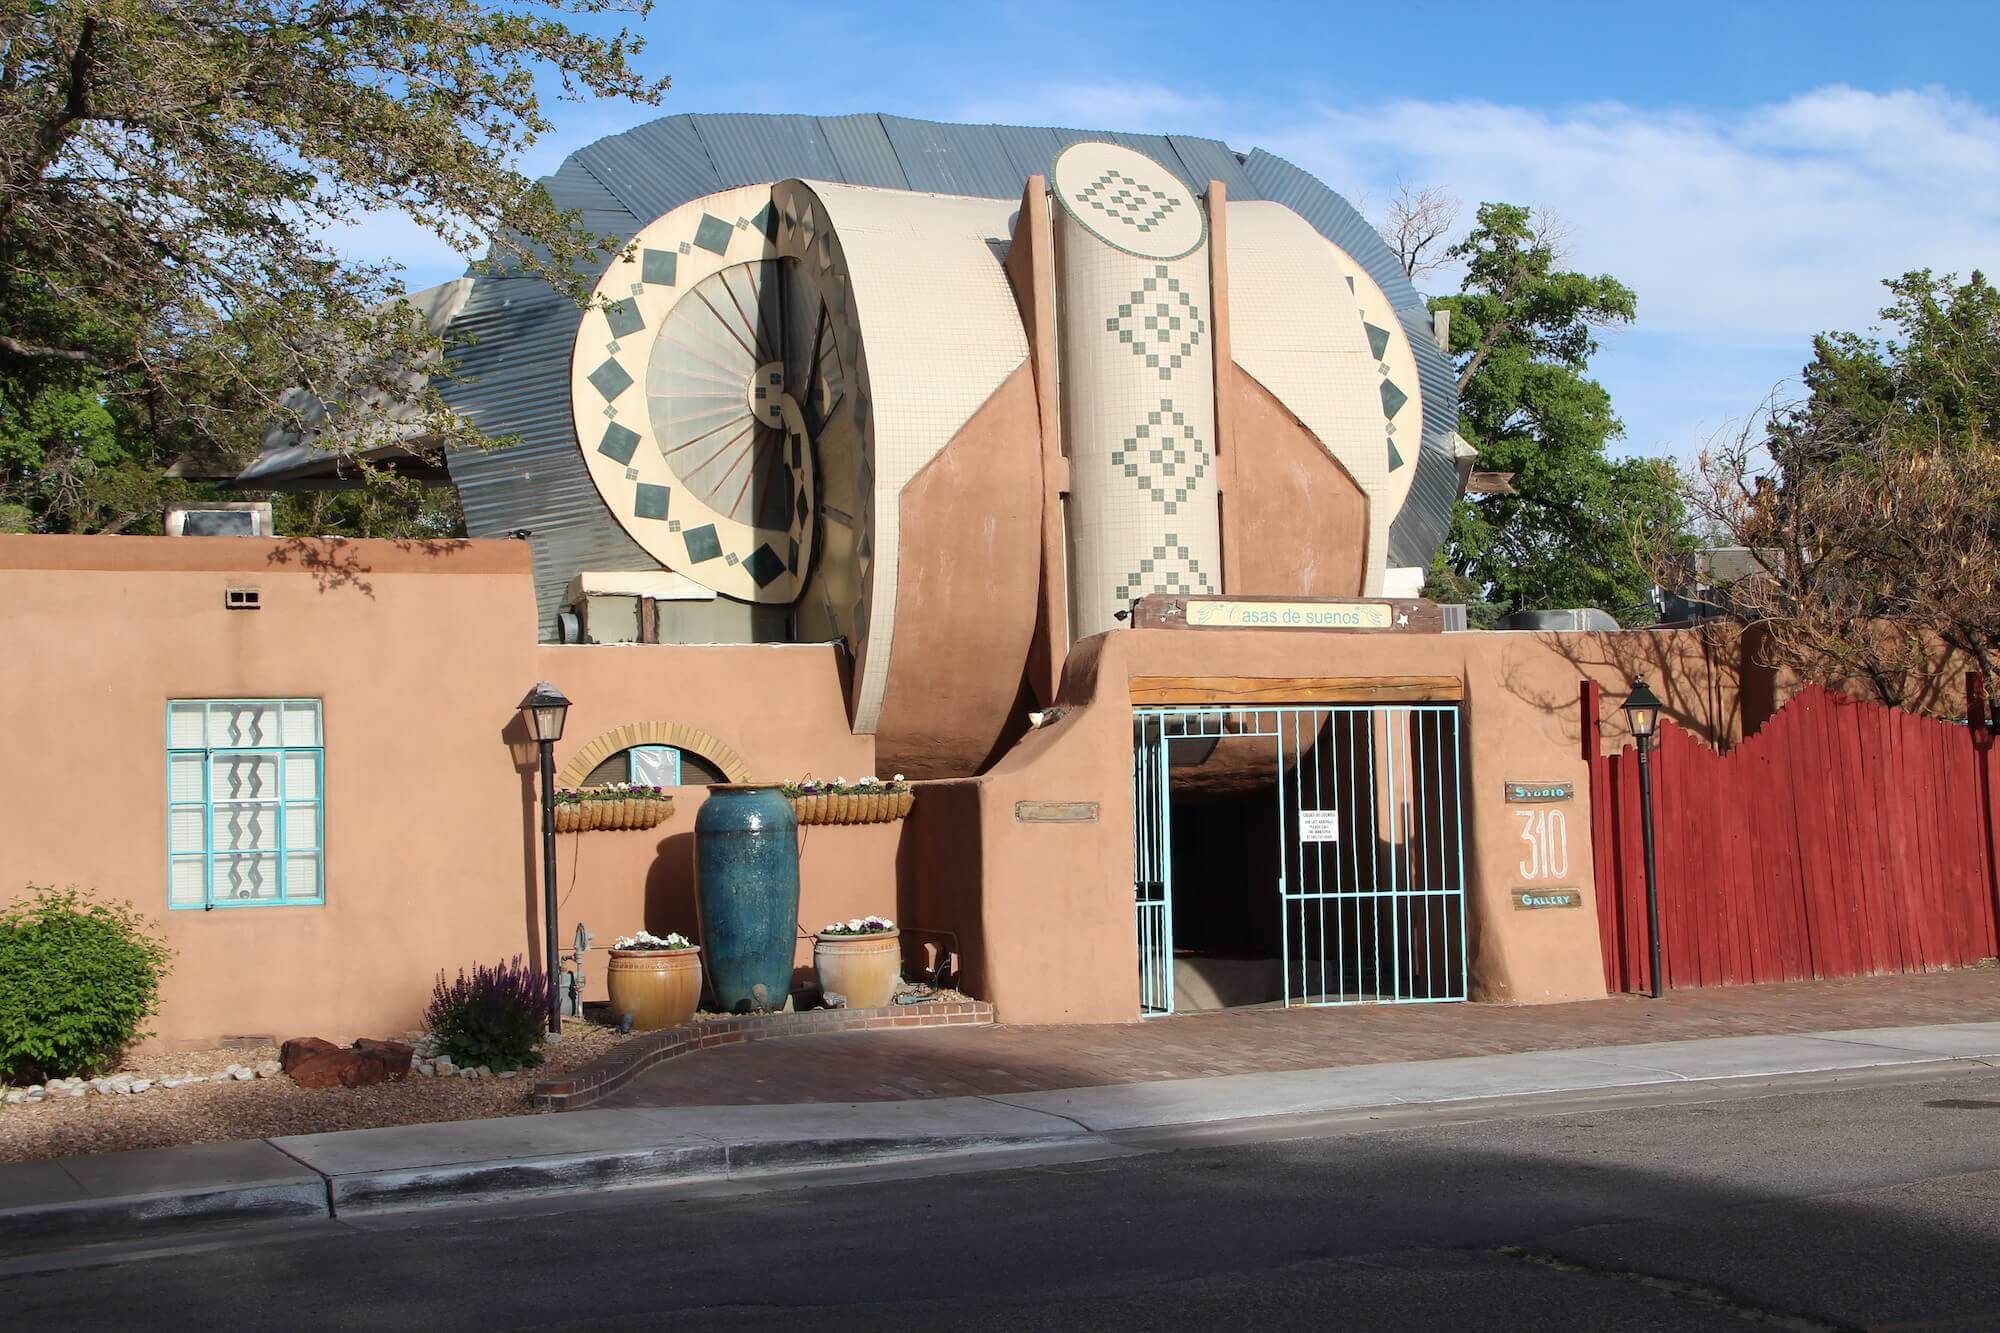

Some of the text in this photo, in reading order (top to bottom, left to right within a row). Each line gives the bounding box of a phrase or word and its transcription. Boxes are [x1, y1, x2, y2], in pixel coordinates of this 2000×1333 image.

[1282, 608, 1301, 624] de
[1306, 611, 1359, 625] suenos
[1515, 808, 1568, 879] 310
